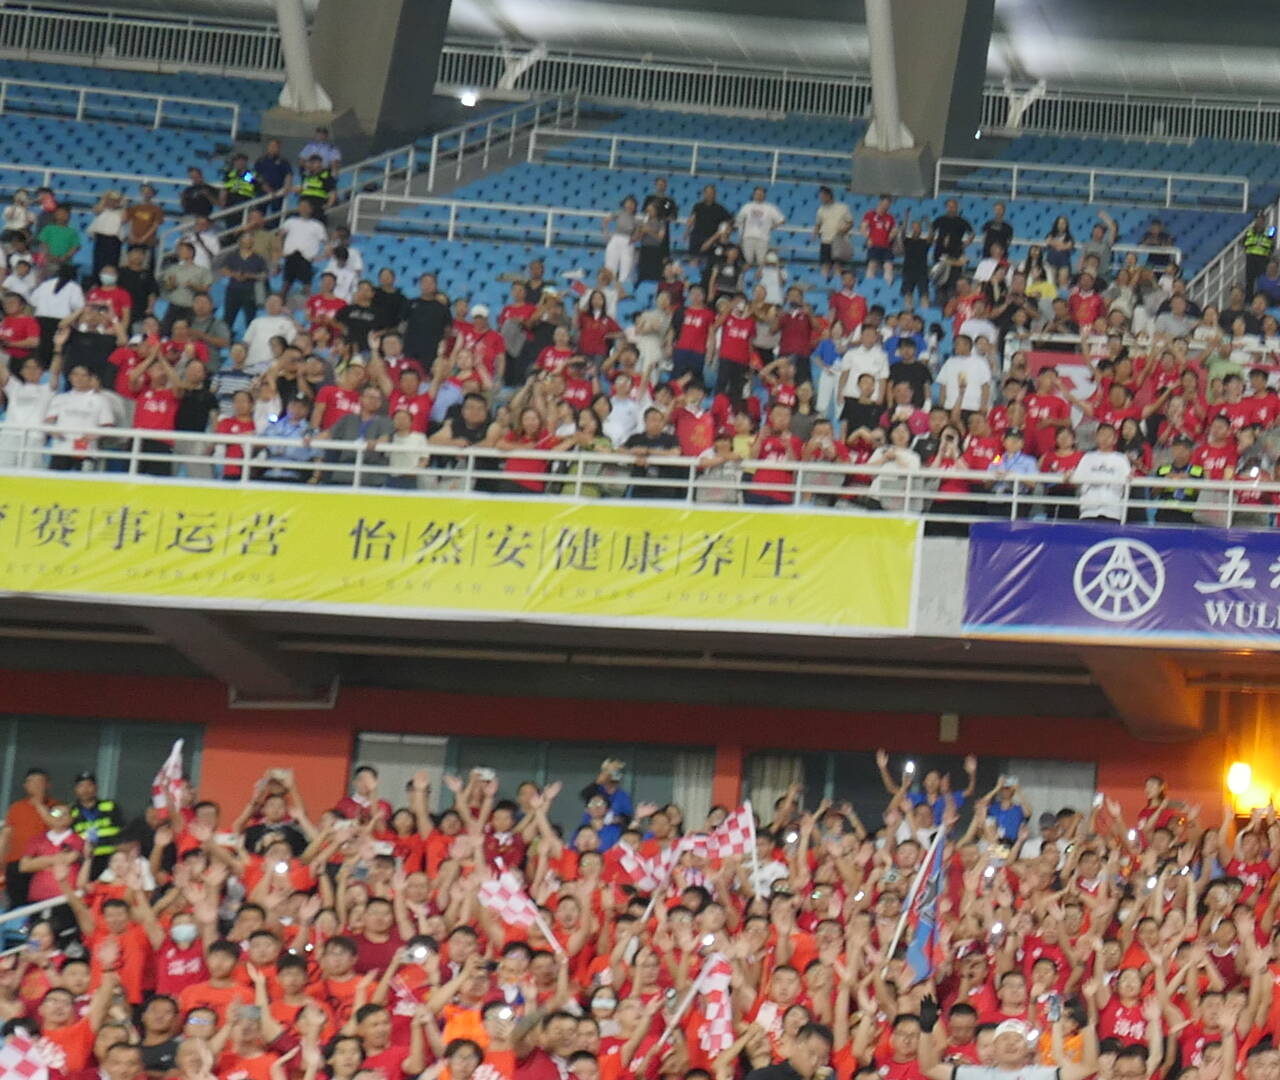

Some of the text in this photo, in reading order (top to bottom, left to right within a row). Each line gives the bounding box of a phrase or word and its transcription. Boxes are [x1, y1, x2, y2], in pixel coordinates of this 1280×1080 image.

[0, 502, 800, 580] 赛事运营 怡然安健康养生
